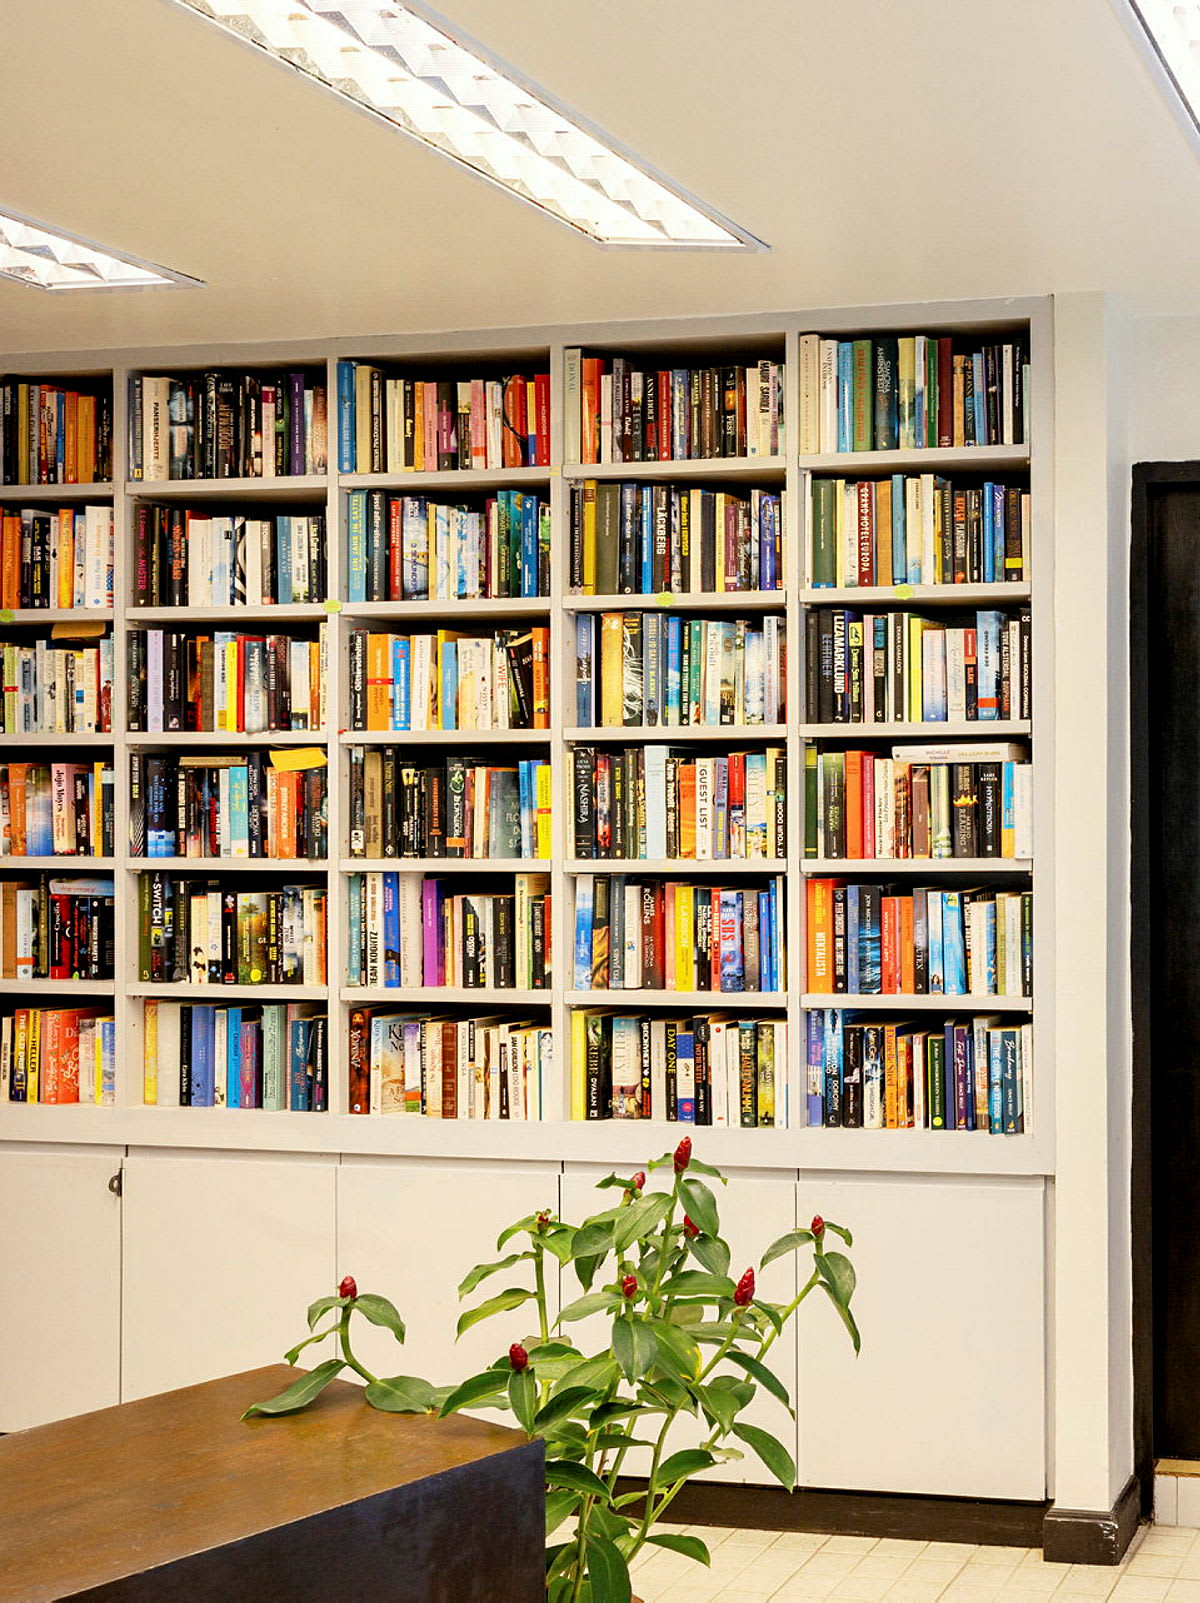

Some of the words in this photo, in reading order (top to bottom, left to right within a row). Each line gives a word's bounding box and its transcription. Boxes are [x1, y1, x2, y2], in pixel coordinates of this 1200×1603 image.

[760, 360, 770, 383] MAURI
[876, 346, 885, 394] AHRNSTEDT
[884, 360, 892, 393] SIMONA
[760, 385, 770, 414] SARIOLA
[656, 507, 666, 555] LÄCKBERG
[859, 517, 870, 540] HOTEL
[859, 542, 870, 573] EUROPA
[137, 558, 147, 591] MISTER
[497, 663, 507, 690] WIFE
[55, 770, 66, 787] Jojo
[699, 768, 708, 804] GUEST
[55, 787, 66, 813] Moyes
[578, 783, 590, 823] NASHIRA
[699, 807, 708, 830] LIST
[959, 807, 967, 846] READING
[777, 845, 783, 858] AT
[152, 883, 162, 924] SWITCH
[643, 887, 651, 925] ROLLINS
[680, 905, 690, 948] LARSSON
[814, 932, 827, 977] MENTALISTA
[18, 1014, 26, 1031] THE
[18, 1033, 26, 1049] OLD
[667, 1028, 677, 1051] DAY
[886, 1028, 896, 1065] Danielle
[667, 1052, 677, 1074] ONE
[886, 1066, 896, 1087] Steel
